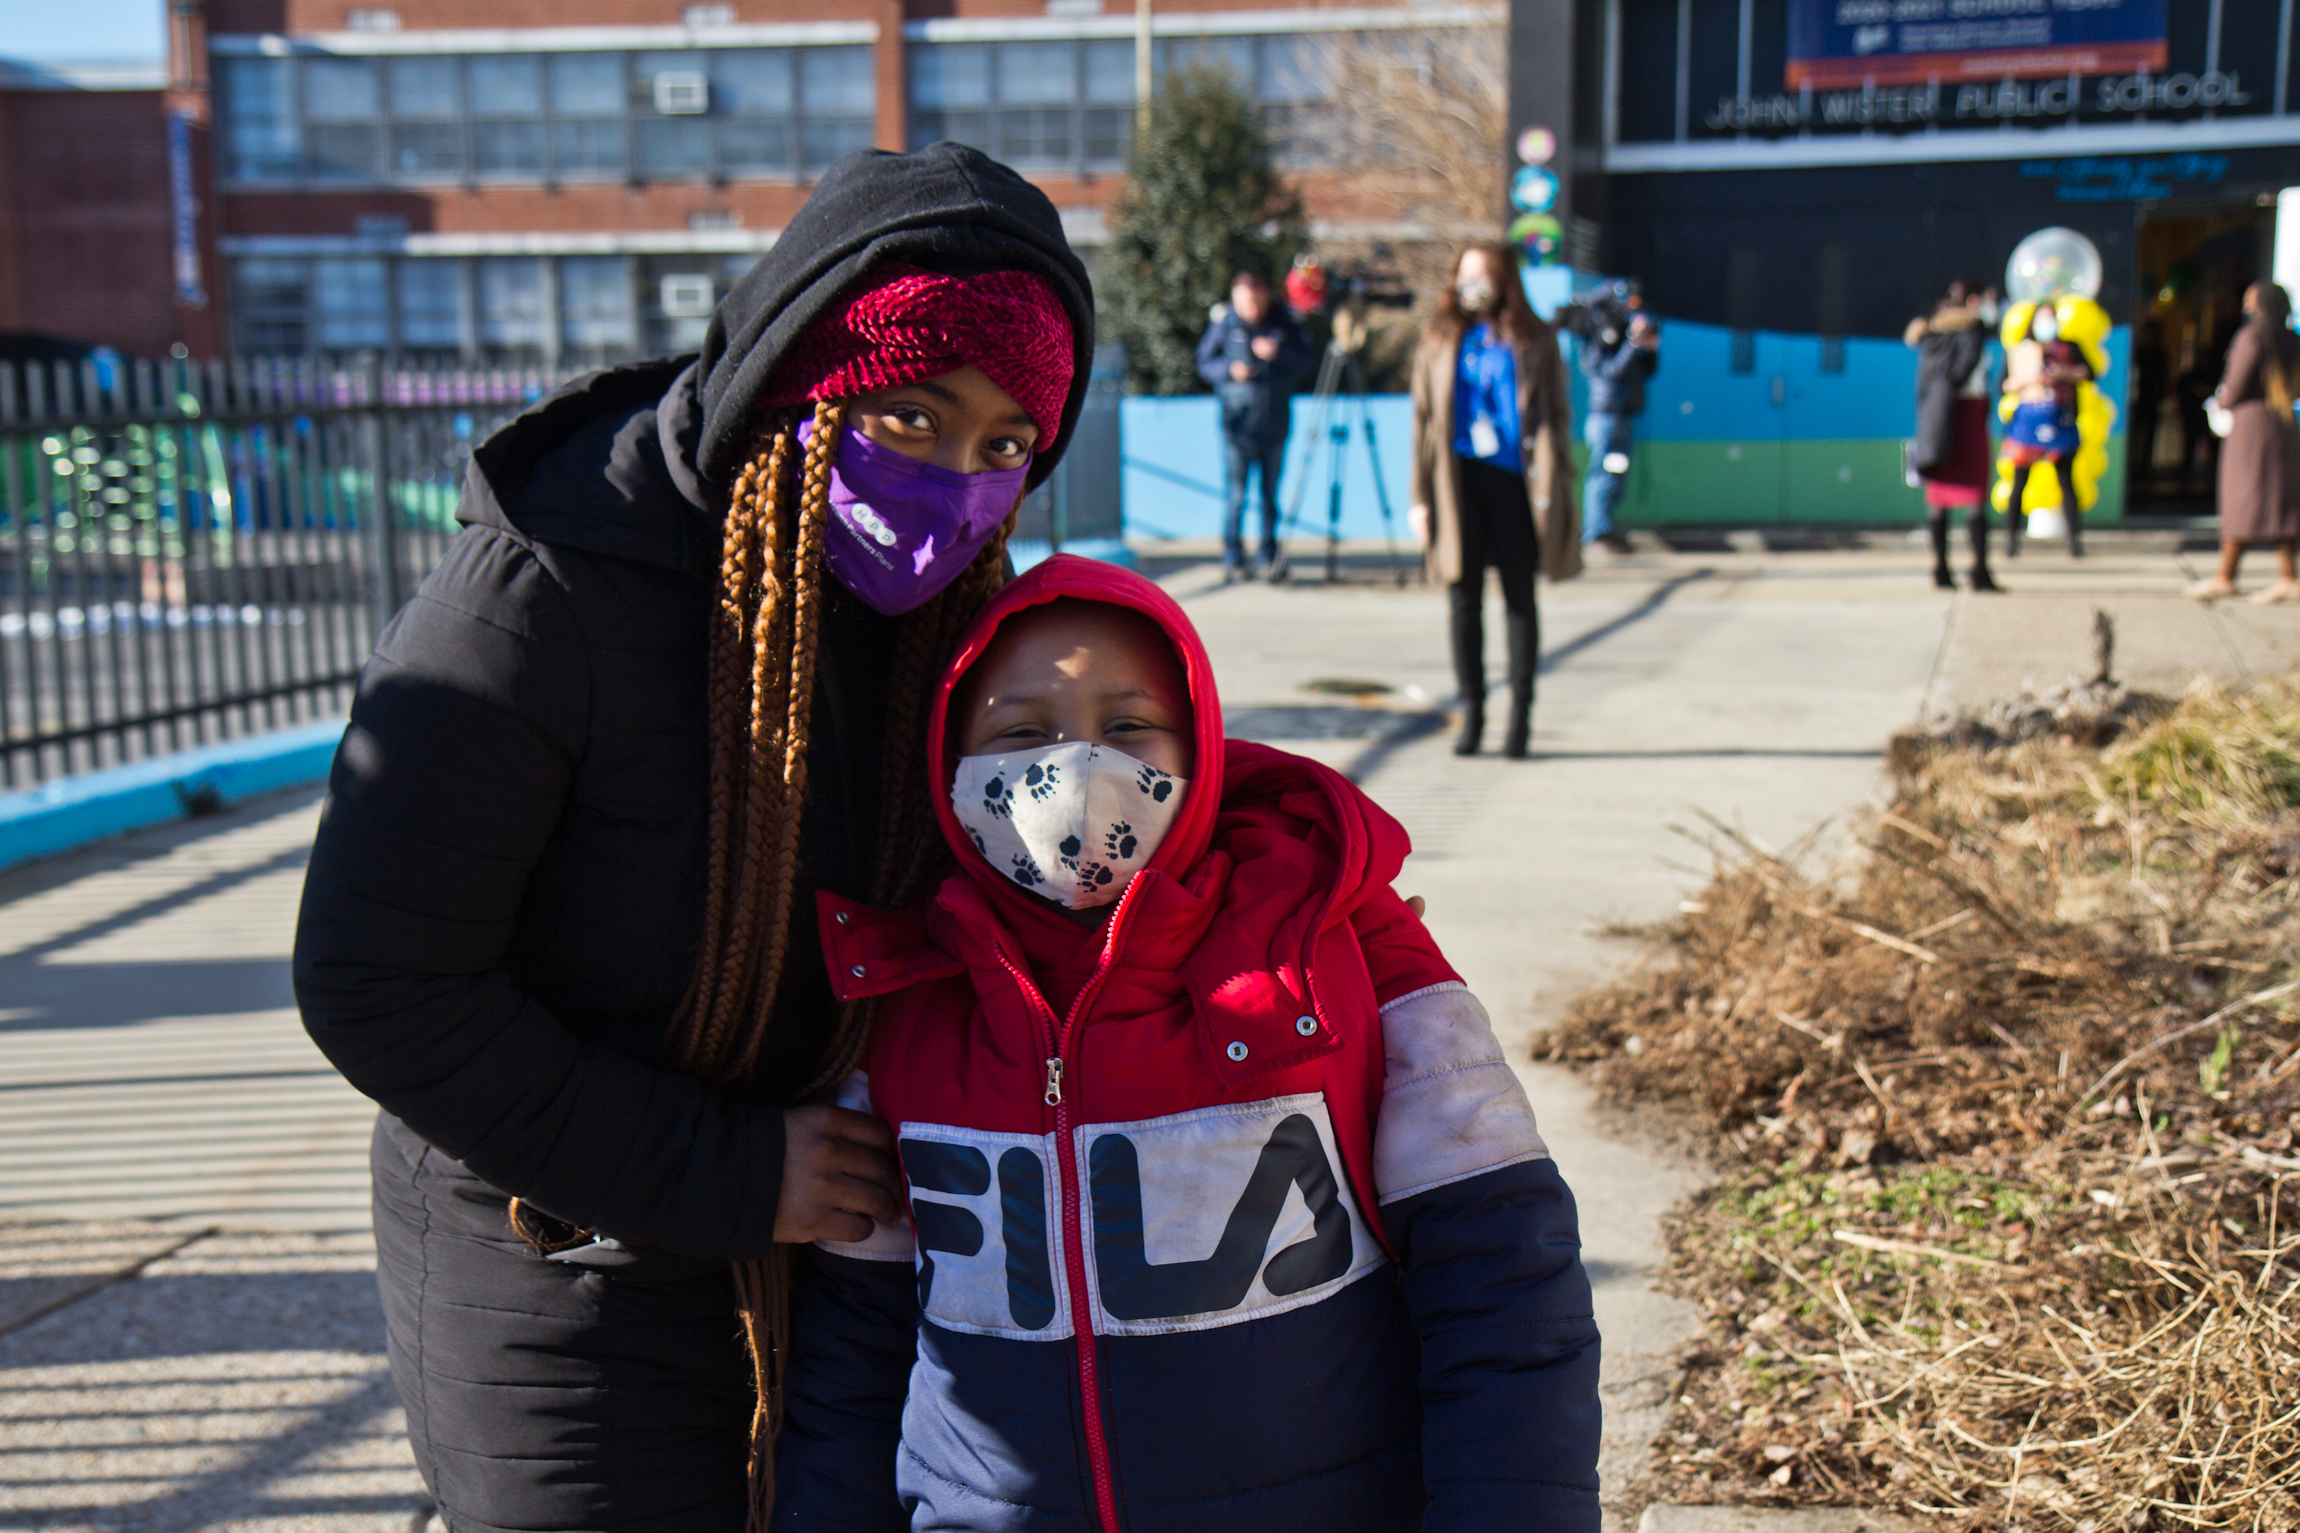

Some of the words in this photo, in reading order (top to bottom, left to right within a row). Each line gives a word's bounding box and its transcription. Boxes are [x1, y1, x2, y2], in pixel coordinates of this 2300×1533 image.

[1705, 93, 1800, 130] JOHN
[1819, 86, 1934, 124] WISTER
[1956, 79, 2072, 118] PUBLIC
[2097, 71, 2249, 112] SCHOOL
[847, 524, 876, 555] Partners
[874, 551, 895, 571] Plans
[854, 507, 894, 543] HPP
[900, 1113, 1353, 1330] FILA
